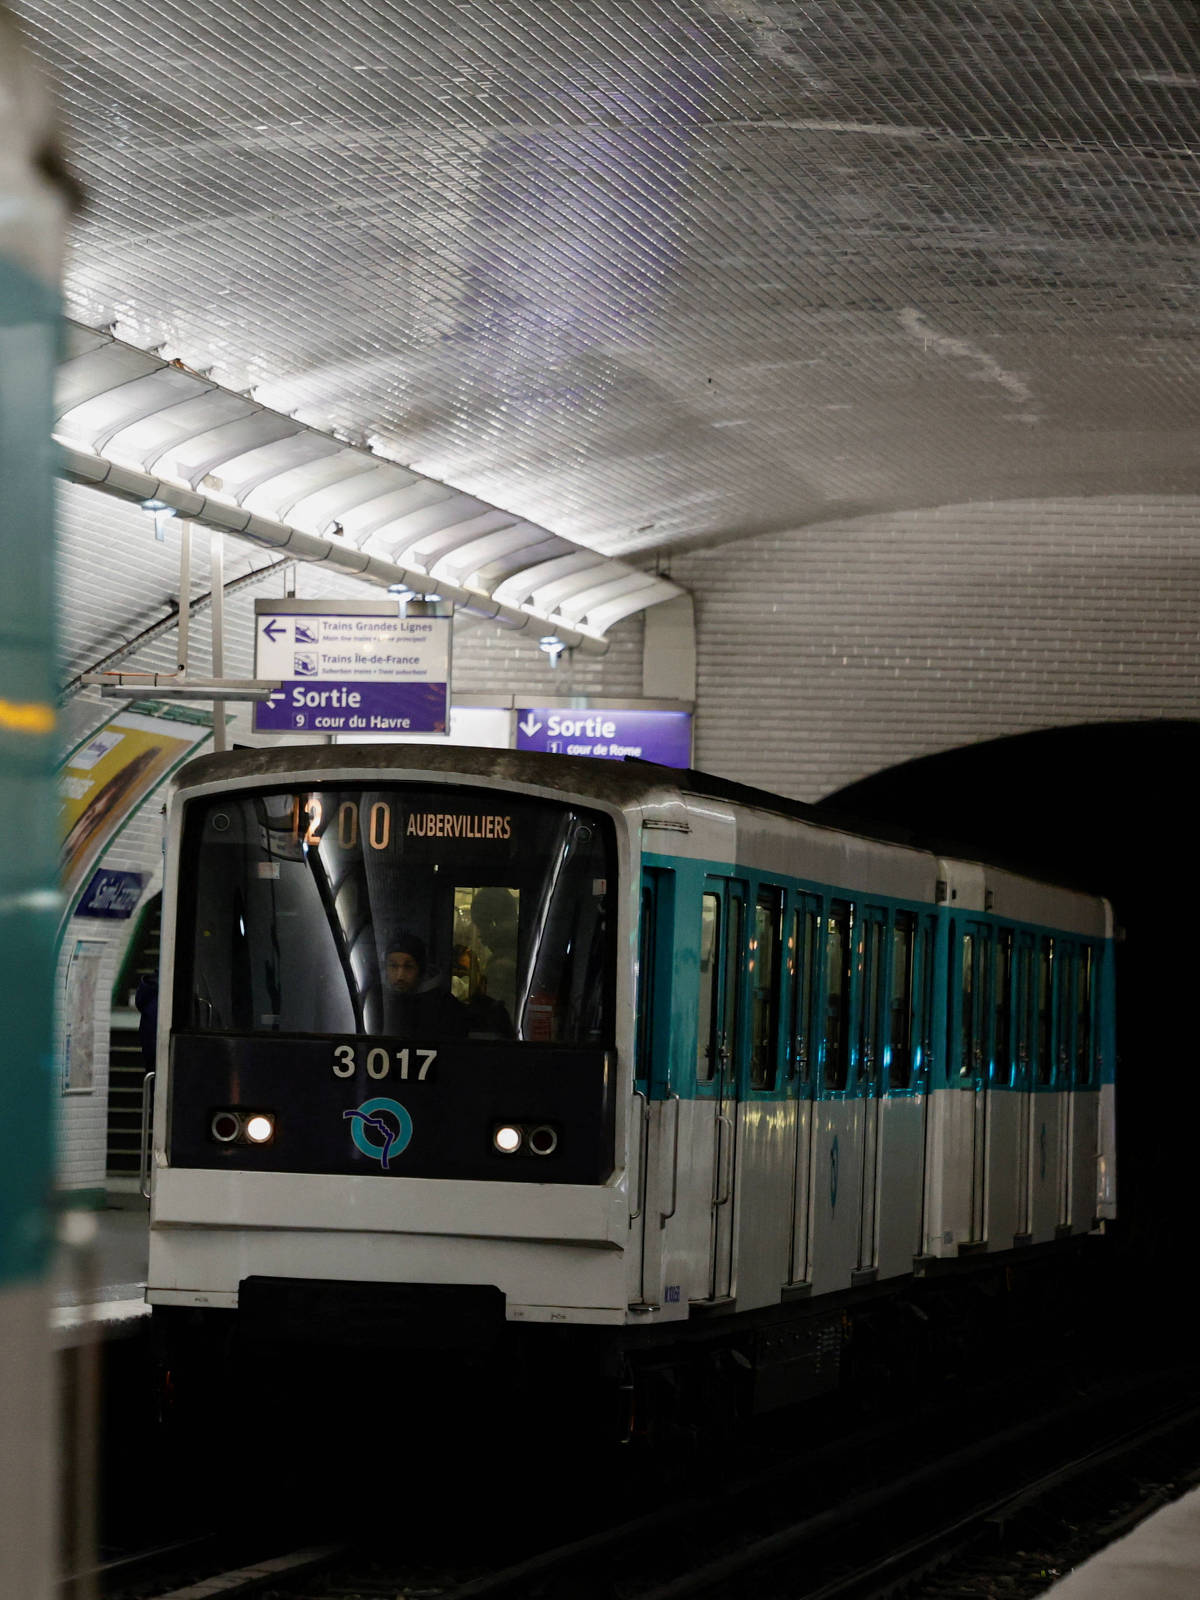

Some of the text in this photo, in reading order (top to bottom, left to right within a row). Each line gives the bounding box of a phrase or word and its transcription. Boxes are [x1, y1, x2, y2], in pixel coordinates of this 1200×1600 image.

[322, 621, 433, 634] Trains Grandes Lignes
[322, 653, 421, 665] Trains Île-de-France
[292, 686, 362, 709] Sortie
[295, 714, 411, 729] 9 cour du Havre
[547, 716, 616, 738] Sortie
[550, 743, 642, 757] 1 cour de Rome
[406, 813, 512, 840] AUBERVILLIERS
